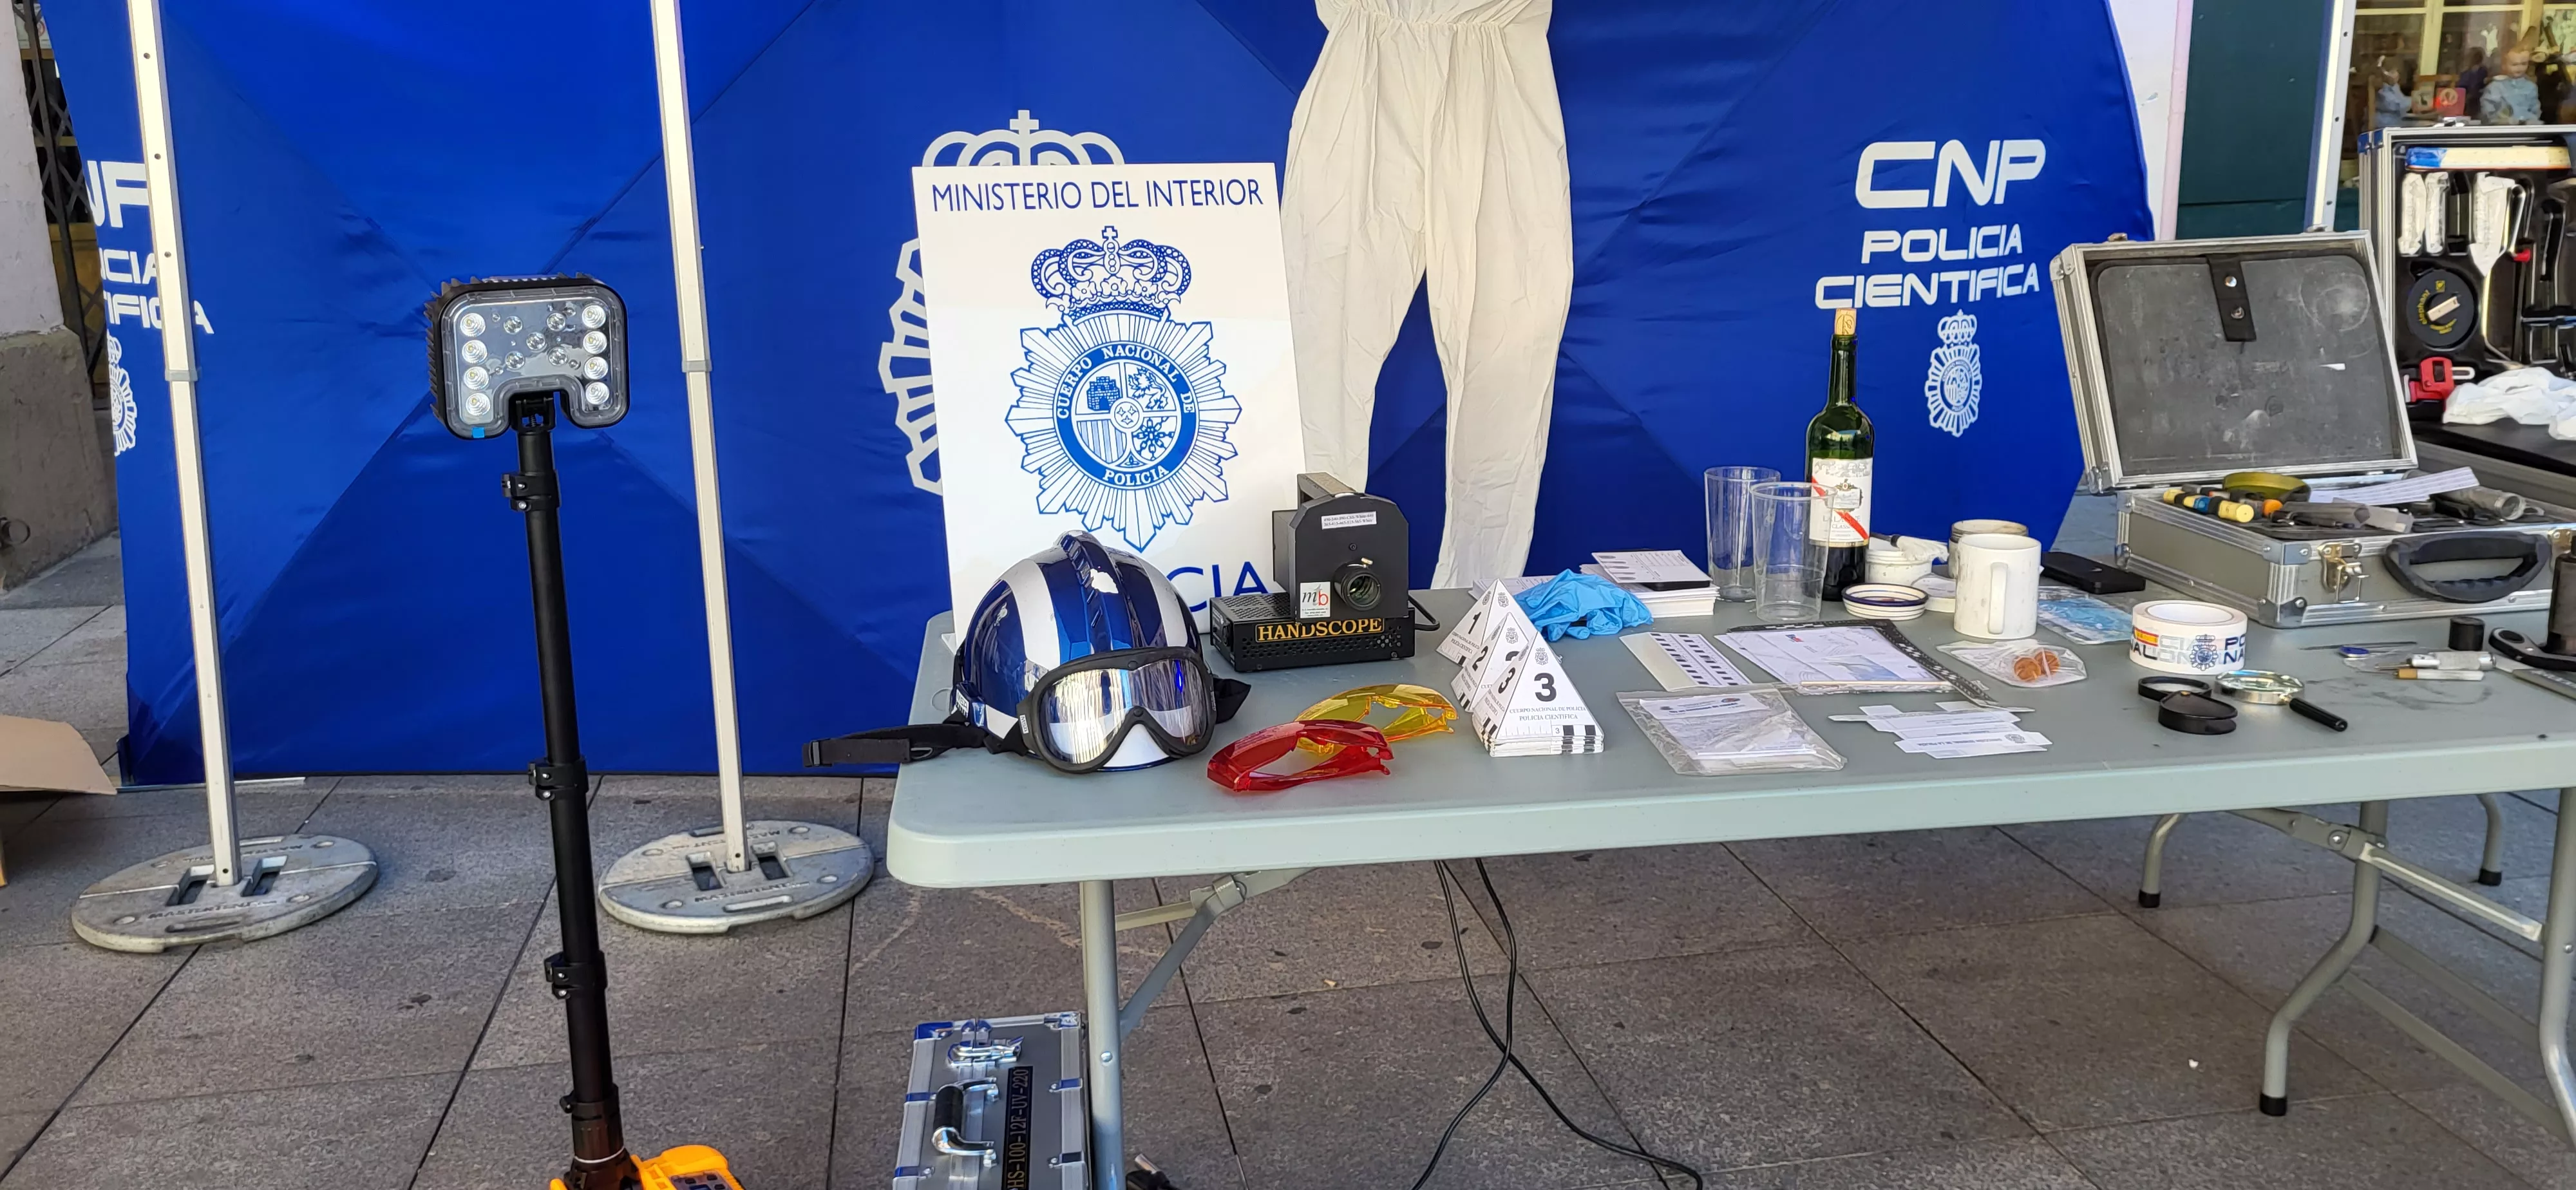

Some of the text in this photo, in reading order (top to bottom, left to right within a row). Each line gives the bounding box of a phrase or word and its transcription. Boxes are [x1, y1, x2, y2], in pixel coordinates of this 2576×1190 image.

[1855, 139, 2046, 209] CNP
[932, 178, 1264, 211] MINISTERIO DEL INTERIOR
[1861, 223, 2022, 263] POLICIA
[1814, 262, 2040, 309] CIENTIFICA
[1057, 345, 1195, 419] CUERPO NACIONAL DE
[1103, 466, 1170, 485] POLICIA
[1258, 618, 1382, 641] HANDSCOPE
[1468, 612, 1481, 634] 1
[1472, 646, 1488, 672] 2
[1498, 667, 1515, 694] 3
[1534, 672, 1557, 702] 3
[1007, 1069, 1029, 1189] HS-100-12F-UV-220
